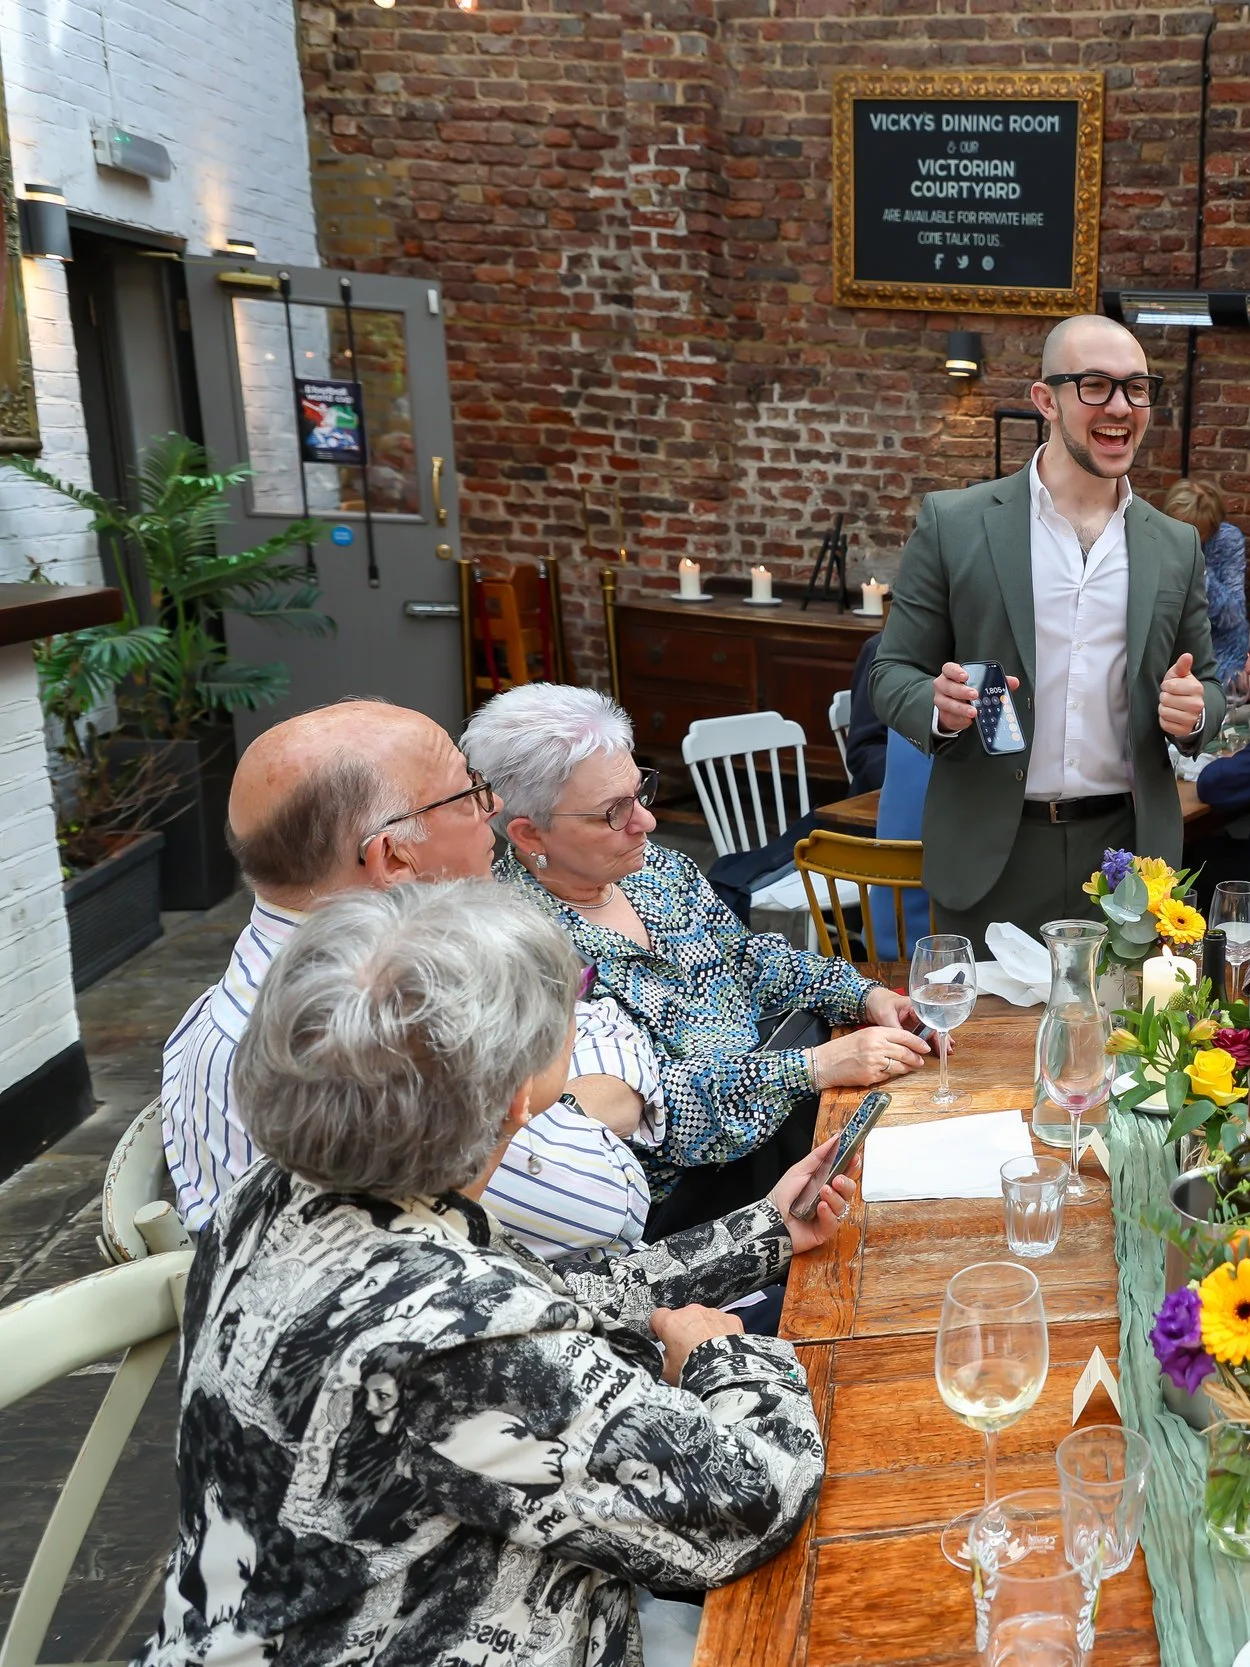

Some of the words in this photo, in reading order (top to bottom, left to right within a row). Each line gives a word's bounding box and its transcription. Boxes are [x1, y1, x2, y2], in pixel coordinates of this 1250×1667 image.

[869, 113, 936, 132] VICKY'S
[941, 114, 1004, 132] DINING
[1008, 115, 1060, 133] ROOM
[959, 141, 979, 154] OUR
[917, 159, 1016, 177] VICTORIAN
[910, 181, 1021, 200] COURTYARD
[882, 208, 902, 222] ARE
[903, 209, 955, 224] AVAILABLE
[957, 211, 976, 225] FOR
[978, 212, 1020, 226] PRIVATE
[1021, 213, 1044, 226] HIRE
[917, 231, 943, 245] COME
[945, 232, 971, 246] TALK
[972, 233, 985, 246] TO
